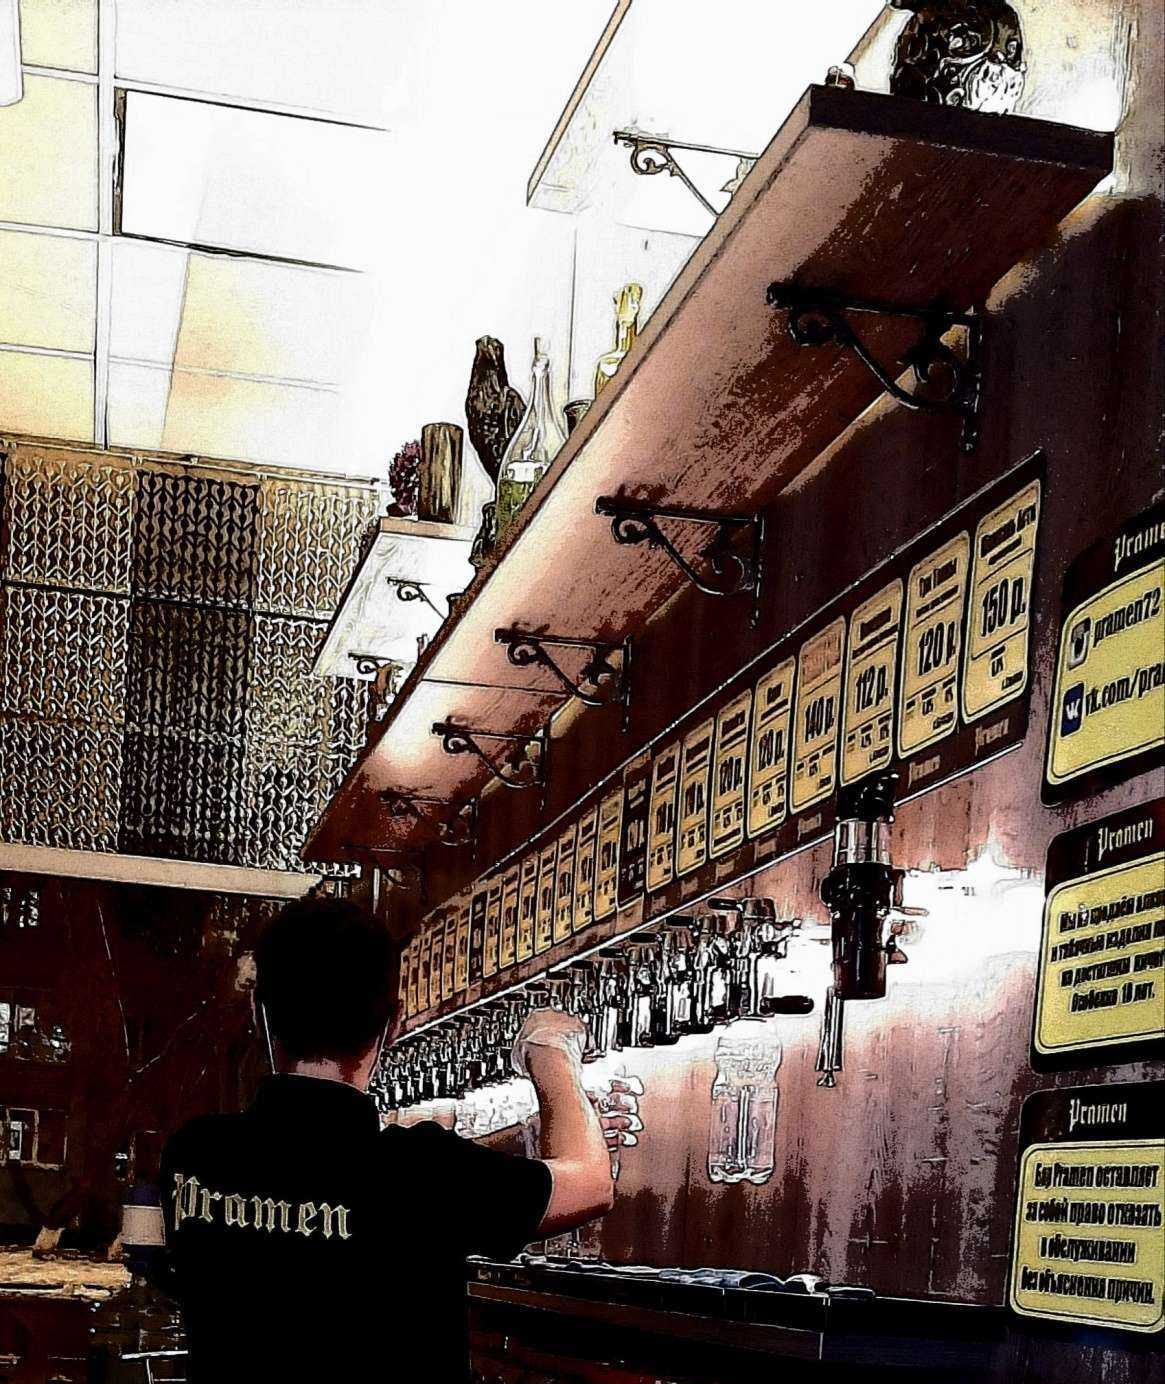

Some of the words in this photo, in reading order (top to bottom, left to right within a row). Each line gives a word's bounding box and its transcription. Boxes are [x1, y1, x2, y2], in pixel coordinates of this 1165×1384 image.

[981, 578, 1010, 638] 150
[1093, 587, 1161, 648] pramen72
[918, 622, 945, 677] 120
[856, 665, 876, 714] 112
[1098, 818, 1153, 862] Pramen
[1069, 1099, 1127, 1133] Pramen
[1034, 1162, 1052, 1189] Бар
[1053, 1163, 1095, 1188] Pramen
[1096, 1164, 1160, 1188] оставляет
[172, 1173, 352, 1240] Pramen
[1025, 1200, 1038, 1222] за
[1038, 1198, 1069, 1222] собой
[1069, 1201, 1106, 1226] право
[1107, 1201, 1162, 1227] отказать
[1040, 1235, 1048, 1258] в
[1048, 1234, 1136, 1264] обслуживании
[1021, 1266, 1039, 1291] без
[1039, 1267, 1107, 1299] объяснения
